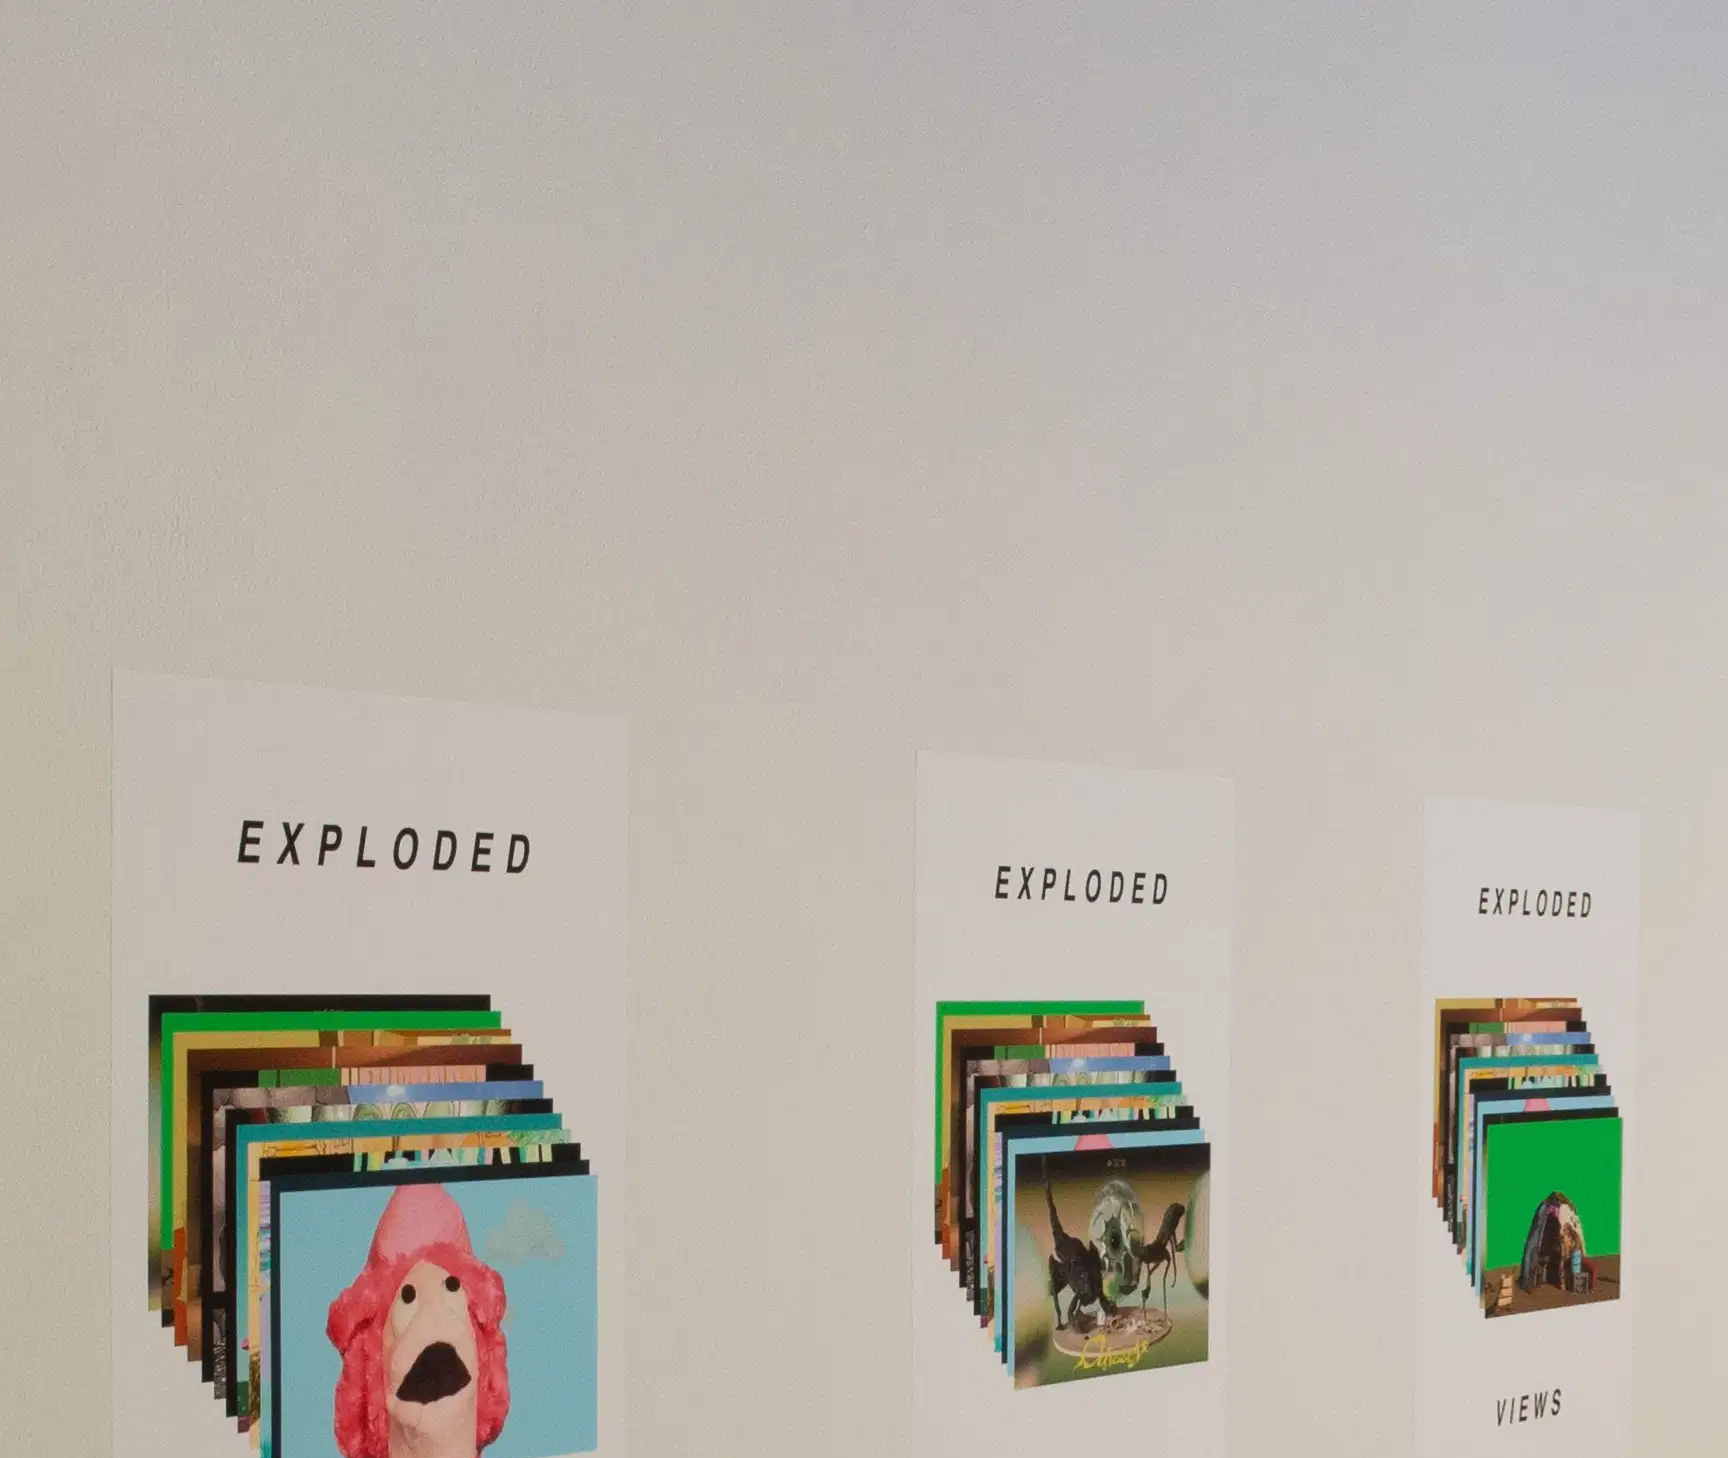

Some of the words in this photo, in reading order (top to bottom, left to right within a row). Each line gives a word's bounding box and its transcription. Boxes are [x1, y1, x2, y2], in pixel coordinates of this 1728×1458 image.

[237, 820, 530, 874] EXPLODED
[994, 865, 1168, 905] EXPLODED
[1478, 887, 1591, 918] EXPLODED
[1497, 1388, 1562, 1427] VIEWS
